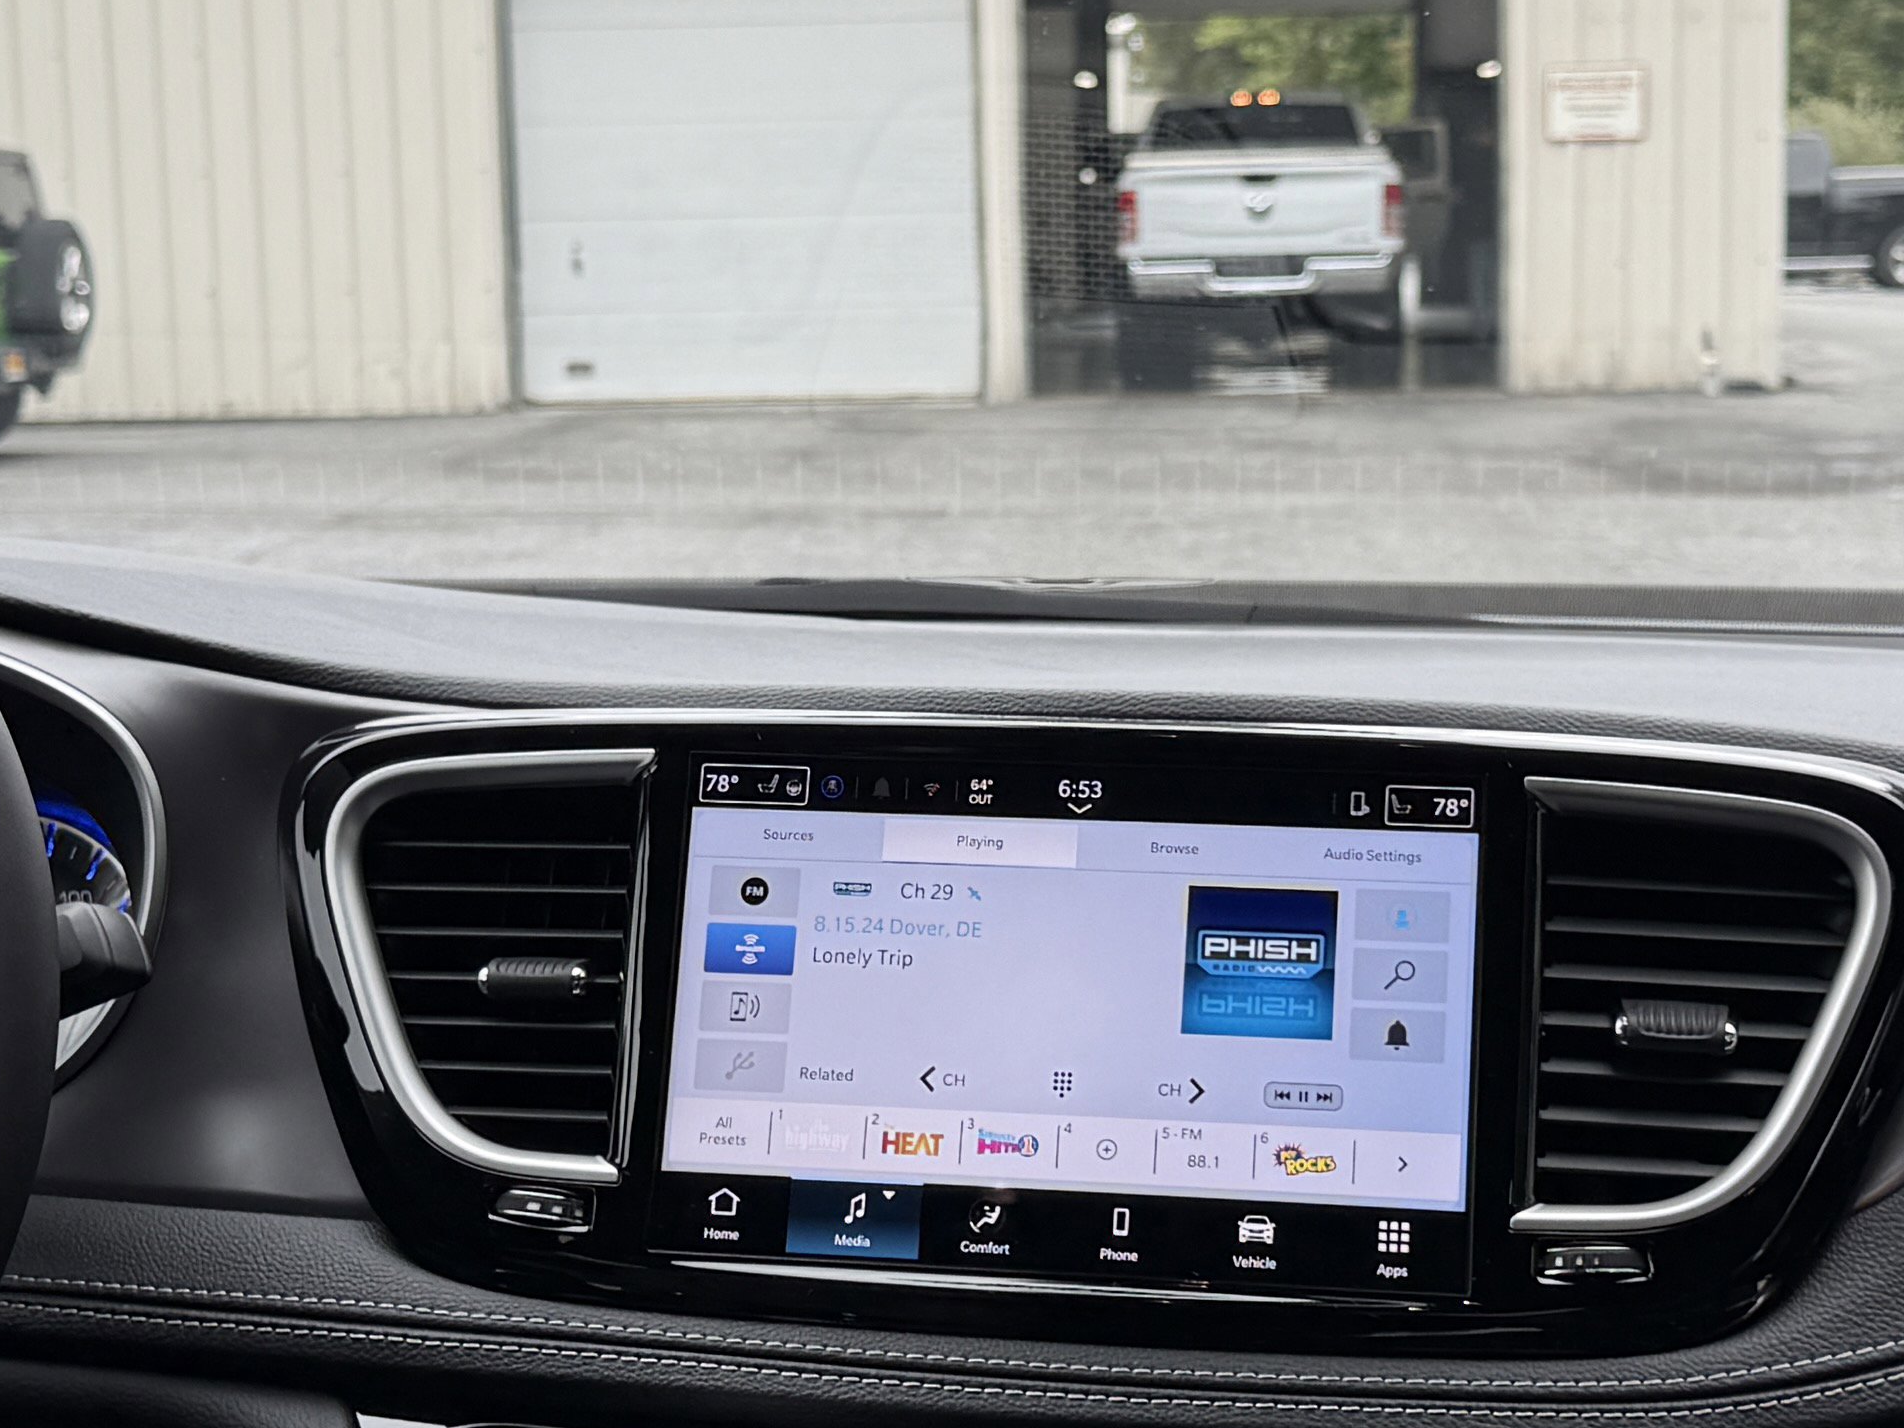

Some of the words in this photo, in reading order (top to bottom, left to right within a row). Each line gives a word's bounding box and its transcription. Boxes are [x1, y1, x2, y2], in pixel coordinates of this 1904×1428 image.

[706, 773, 739, 793] 78°
[1058, 780, 1102, 799] 6:53
[969, 794, 993, 805] OUT
[1433, 798, 1469, 817] 78°
[763, 829, 814, 842] Sources
[957, 835, 1004, 851] Playing
[1150, 842, 1199, 855] Browse
[1324, 848, 1364, 862] Audio
[1366, 849, 1422, 865] Settings
[745, 885, 764, 896] FM
[901, 883, 925, 900] Ch
[929, 884, 954, 901] 29
[814, 916, 884, 935] 8.15.24
[890, 919, 950, 939] Dover,
[957, 922, 982, 938] DE
[1204, 937, 1317, 961] PHISH
[813, 947, 872, 968] Lonely
[878, 950, 914, 969] Trip
[1213, 963, 1256, 972] RADIO
[799, 1066, 854, 1083] Related
[943, 1073, 966, 1087] CH
[1158, 1083, 1182, 1097] CH
[716, 1116, 732, 1129] All
[871, 1114, 880, 1126] 2
[967, 1118, 975, 1130] 3
[1064, 1123, 1073, 1134] 4
[1182, 1129, 1202, 1140] FM
[699, 1131, 747, 1147] Presets
[881, 1130, 944, 1156] HEAT
[1261, 1132, 1268, 1144] 6
[1187, 1155, 1219, 1169] 88.1
[1285, 1156, 1337, 1176] ROCKS
[703, 1227, 740, 1241] Home
[834, 1234, 871, 1248] Media
[960, 1241, 1010, 1255] Comfort
[1100, 1247, 1138, 1262] Phone
[1233, 1256, 1277, 1270] Vehicle
[1376, 1264, 1408, 1278] Apps
